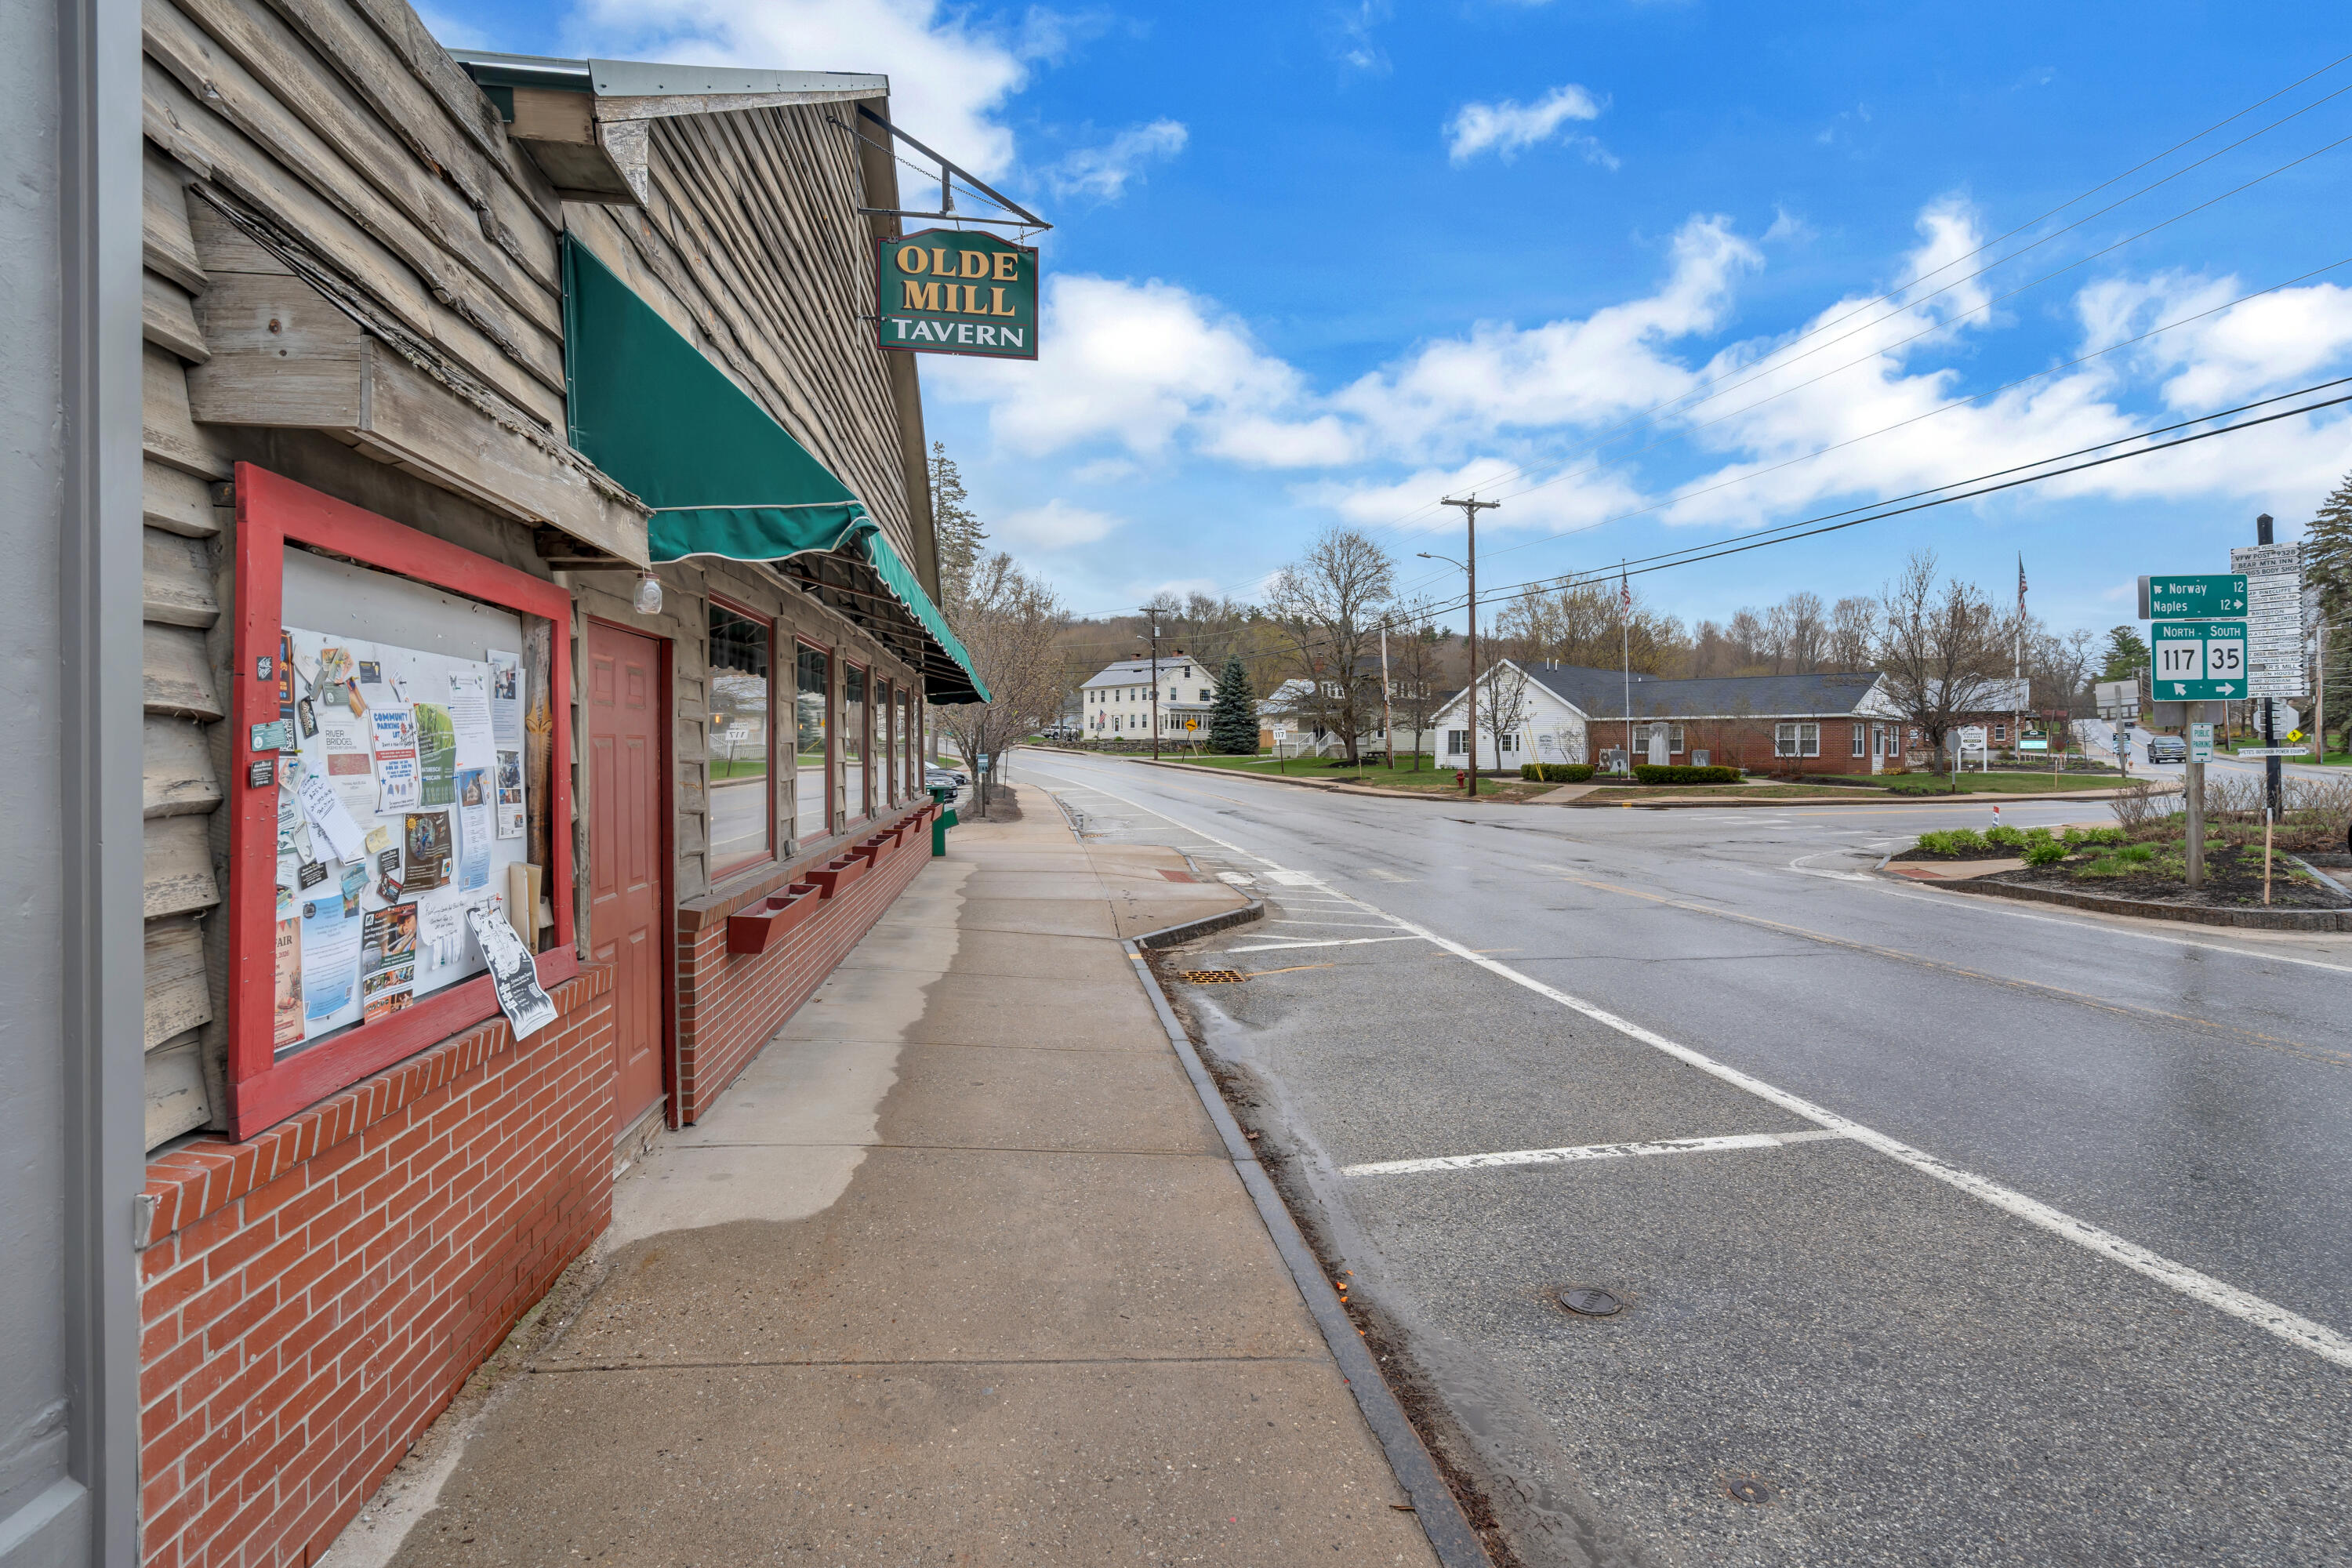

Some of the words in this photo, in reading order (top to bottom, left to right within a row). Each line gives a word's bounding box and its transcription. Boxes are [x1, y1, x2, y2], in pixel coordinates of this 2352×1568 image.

[895, 245, 1018, 281] OLDE
[902, 280, 1015, 317] MILL
[891, 318, 1023, 347] TAVERN
[2169, 583, 2207, 596] Norway
[2234, 582, 2245, 593] 12
[2154, 601, 2188, 614] Naples
[2220, 599, 2231, 610] 12
[2163, 626, 2194, 637] NORTH
[2210, 626, 2241, 637] SOUTH
[2164, 649, 2195, 670] 117
[2212, 648, 2239, 670] 35
[373, 713, 408, 722] COMMUNITY
[325, 729, 345, 738] RIVER
[2194, 729, 2210, 738] PUBLIC
[2193, 740, 2212, 749] PARKING
[275, 935, 292, 948] AIR
